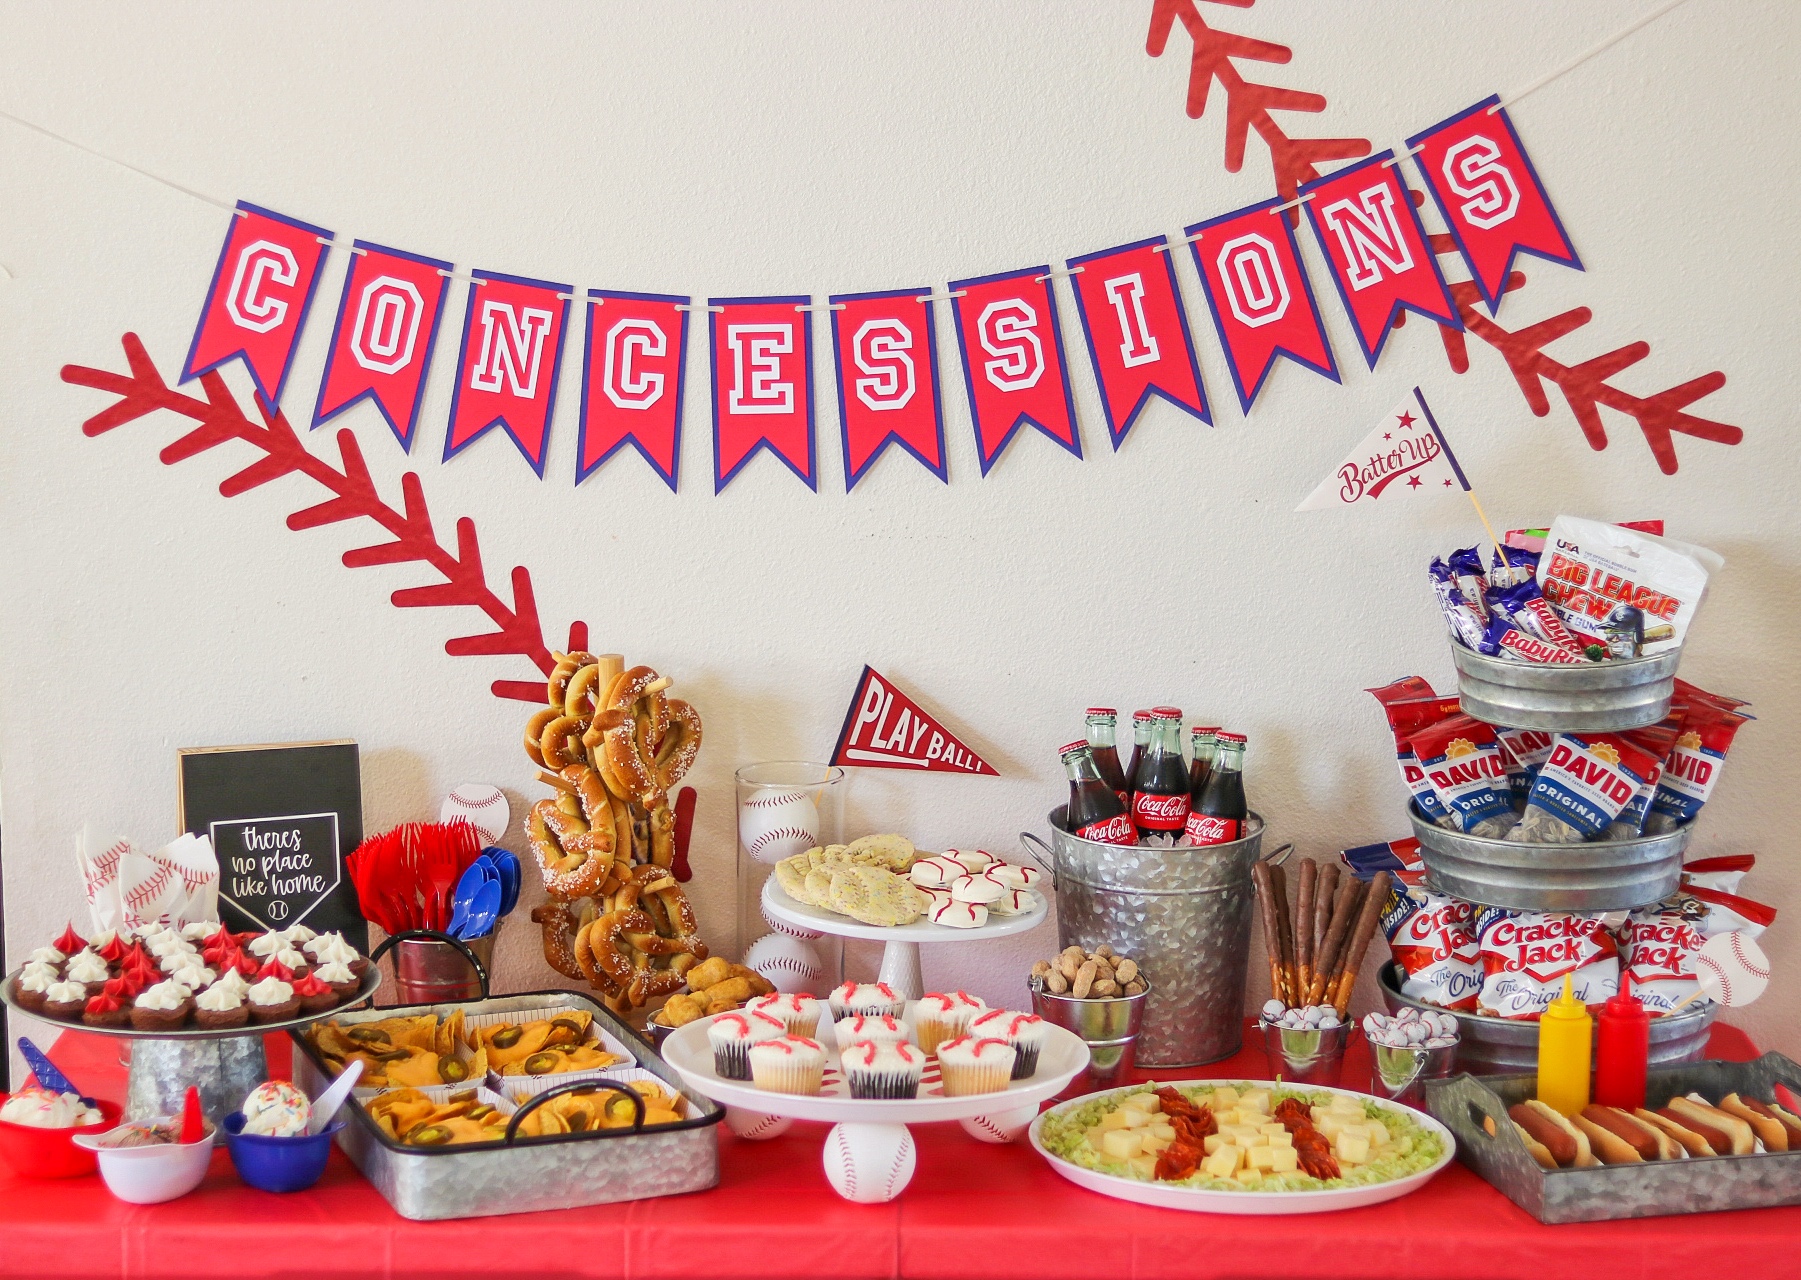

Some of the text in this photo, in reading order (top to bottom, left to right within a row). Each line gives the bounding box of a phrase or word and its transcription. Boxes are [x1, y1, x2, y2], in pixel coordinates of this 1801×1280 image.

[226, 134, 1520, 415] CONCESSIONS
[1337, 449, 1404, 503] Batter
[1542, 576, 1616, 622] CHEW
[1546, 552, 1681, 622] BIG LEAGUE
[1574, 616, 1597, 633] GUM
[848, 675, 983, 773] PLAY BALL!
[1504, 731, 1552, 756] DAV
[1429, 754, 1507, 790] DAVID
[1548, 744, 1633, 806] DAVID
[1664, 751, 1713, 786] AVID
[1137, 794, 1186, 817] Coca-Cola
[1537, 783, 1602, 829] ORIGINAL
[241, 826, 301, 851] theres
[231, 850, 313, 880] no place
[232, 874, 326, 898] like home
[1410, 902, 1471, 940] Crac
[1491, 915, 1599, 947] Cracke
[1615, 919, 1705, 952] Cracke
[1433, 923, 1479, 962] Jac
[1504, 937, 1583, 973] Jack
[1619, 943, 1687, 975] Jack
[1496, 978, 1519, 998] The
[1511, 981, 1590, 1013] Origial
